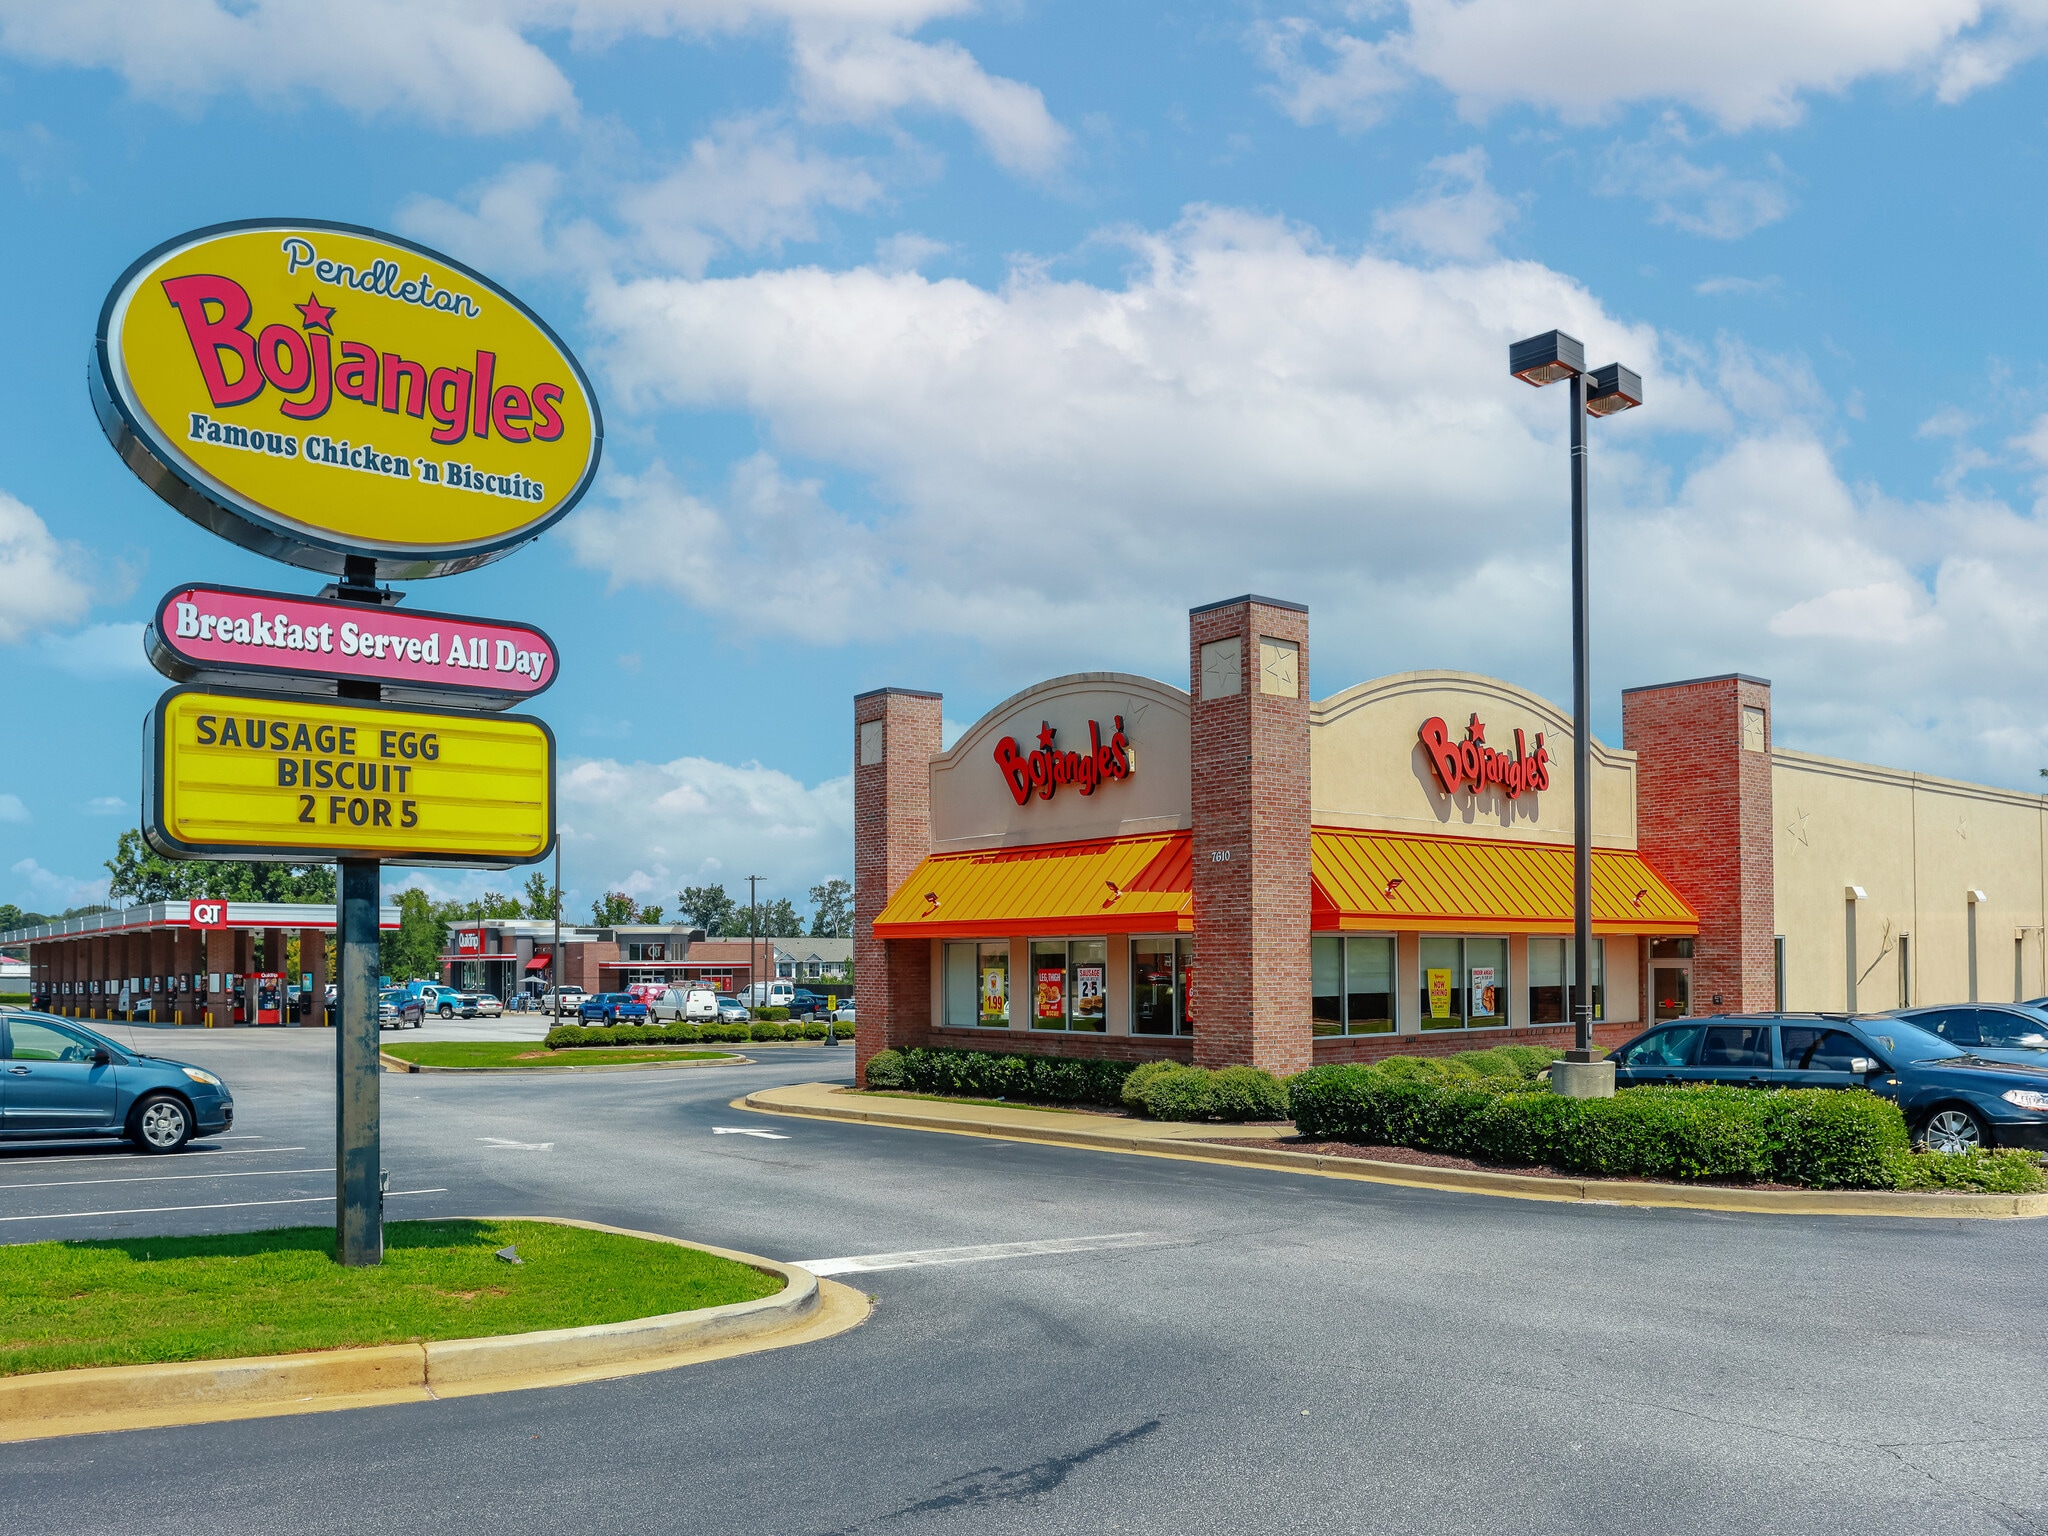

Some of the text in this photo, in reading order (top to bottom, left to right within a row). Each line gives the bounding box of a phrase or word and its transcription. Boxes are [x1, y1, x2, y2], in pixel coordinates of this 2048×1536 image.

[281, 237, 480, 318] Pendleton
[160, 274, 564, 445] Bojangles
[189, 413, 298, 457] Famous
[305, 435, 411, 477] Chicken
[446, 461, 544, 501] Biscuits
[176, 602, 548, 682] Breakfast Served All Day
[196, 715, 440, 761] SAUSAGE EGG
[994, 714, 1130, 806] Bojangle's
[1418, 712, 1550, 800] Bojangle's
[277, 758, 413, 793] BISCUIT
[298, 795, 419, 829] 2 FOR 5
[1211, 850, 1231, 863] 7610
[193, 904, 222, 925] QT
[647, 945, 663, 959] QT
